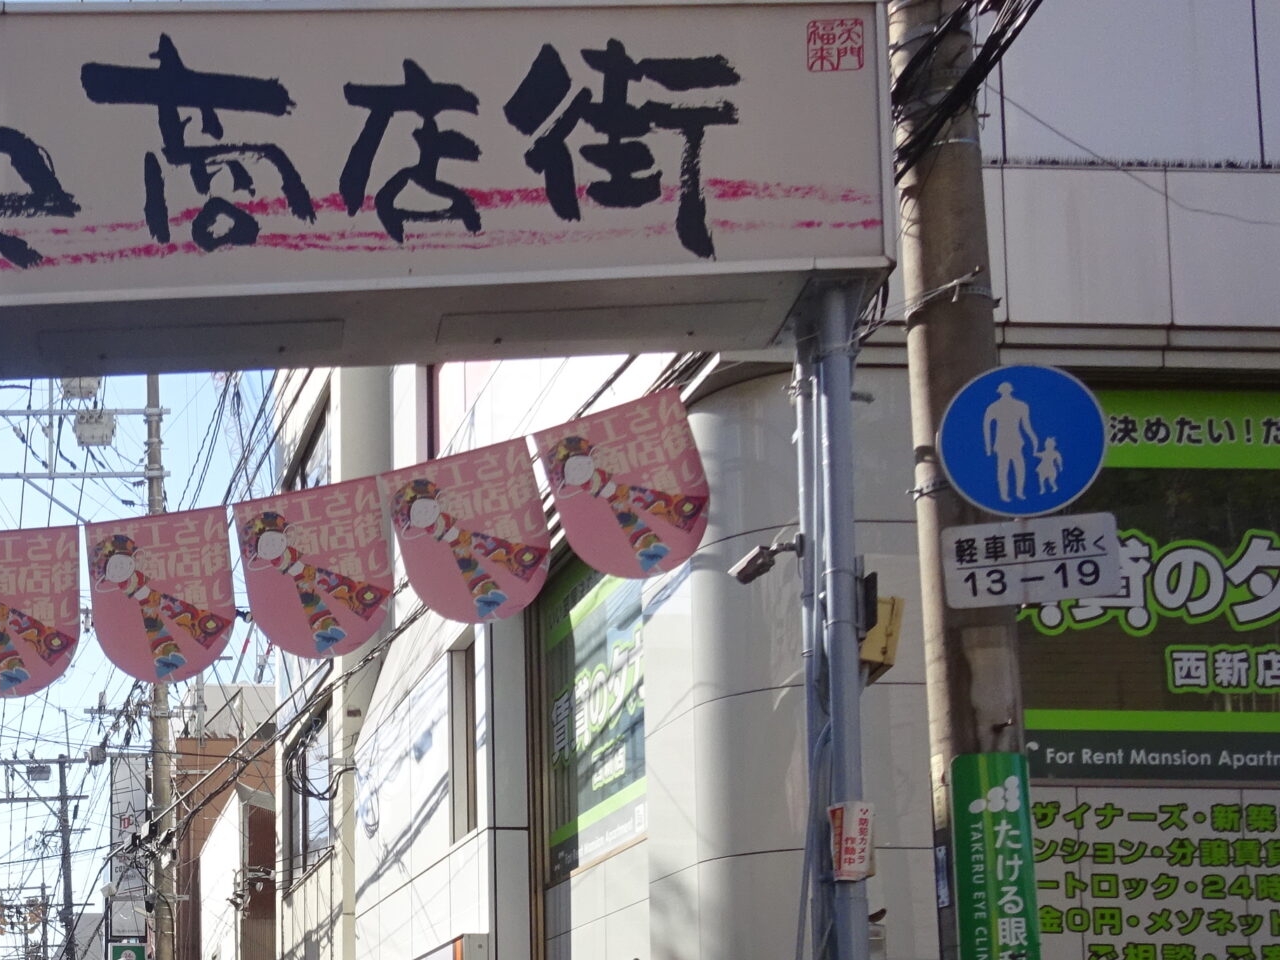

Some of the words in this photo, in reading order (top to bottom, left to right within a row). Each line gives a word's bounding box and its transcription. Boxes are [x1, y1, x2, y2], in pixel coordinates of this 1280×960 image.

[954, 527, 1106, 564] 軽車両を除く
[1046, 748, 1075, 764] For
[1082, 748, 1123, 765] Rent
[1130, 750, 1211, 766] Mansion
[970, 821, 984, 884] TAKERU
[973, 891, 987, 919] EYE
